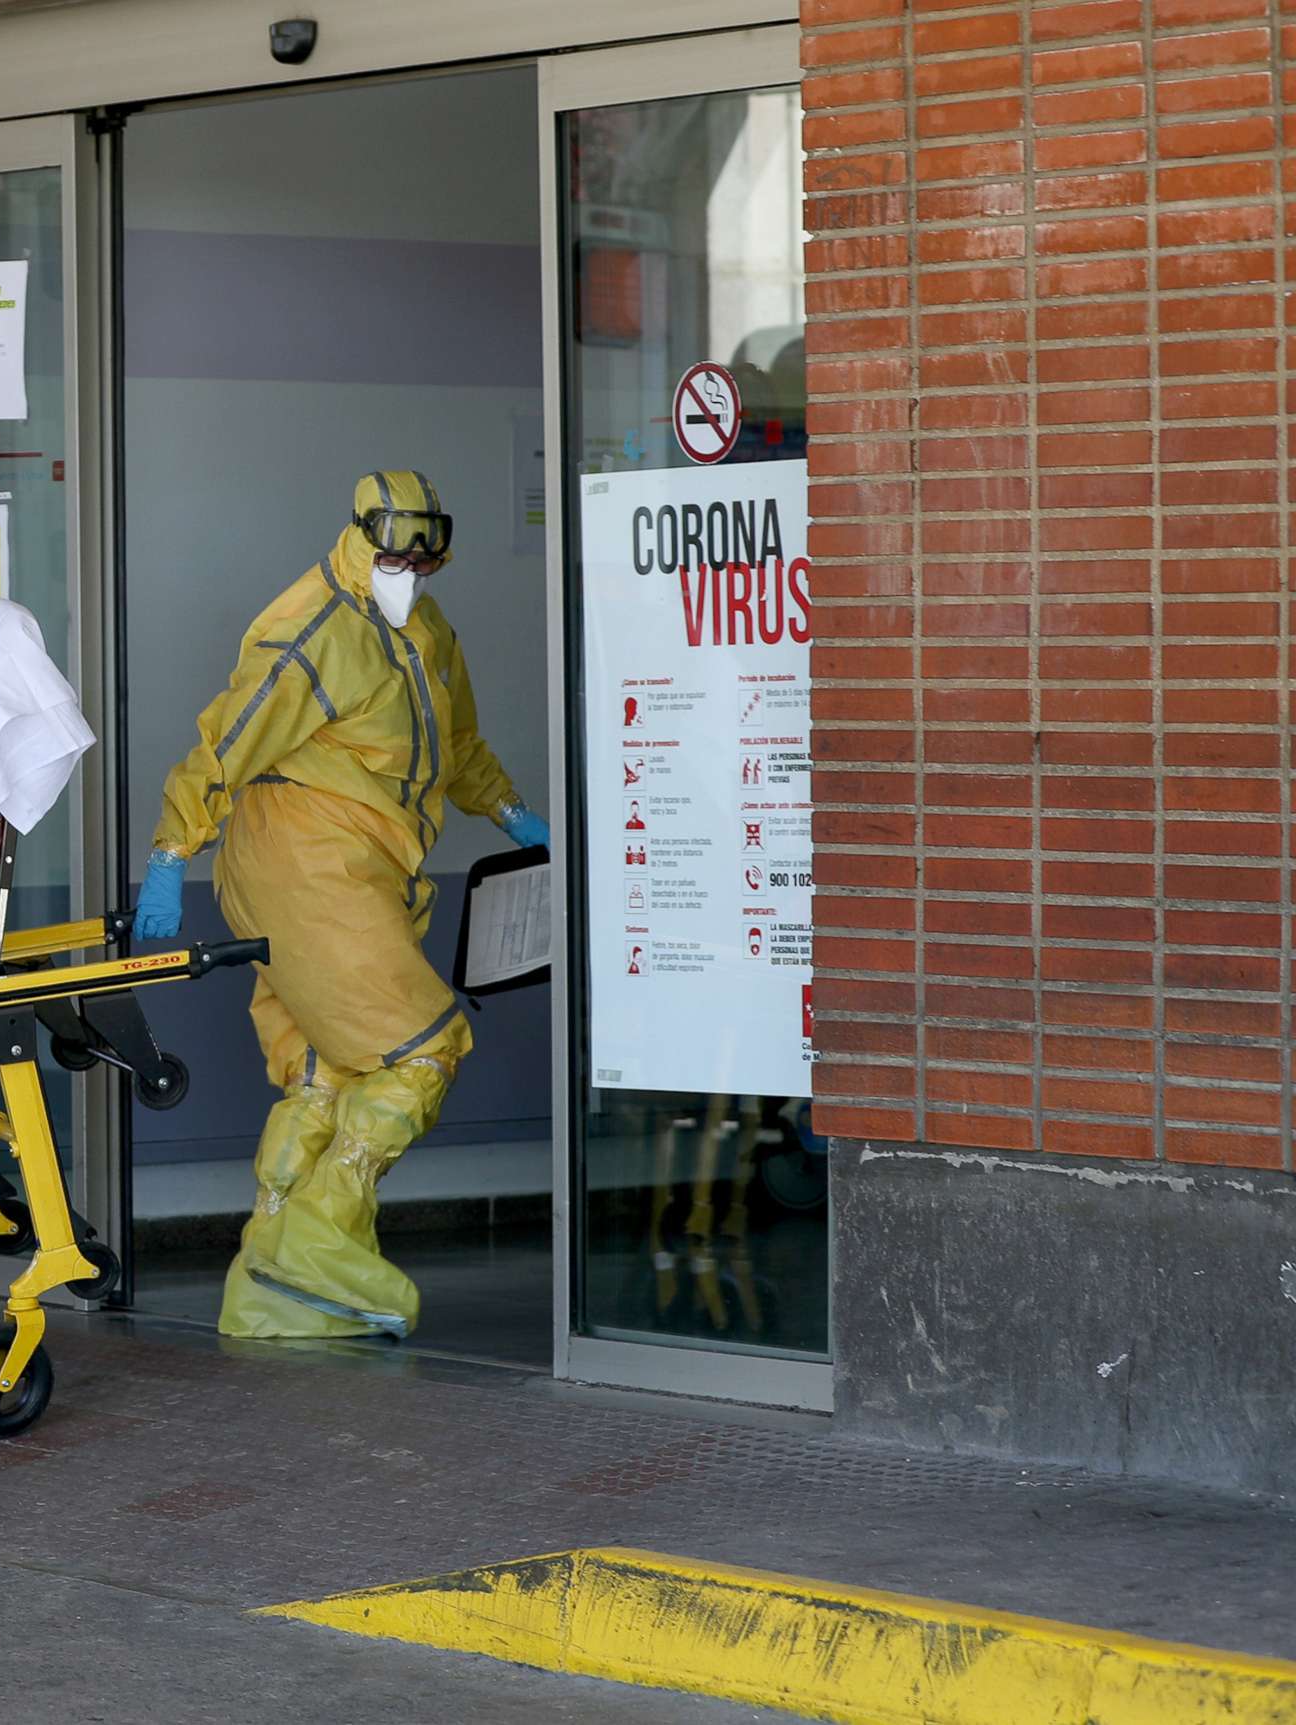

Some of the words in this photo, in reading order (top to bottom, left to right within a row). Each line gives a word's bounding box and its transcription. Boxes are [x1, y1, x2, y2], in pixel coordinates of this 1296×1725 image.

[633, 498, 785, 576] CORONA
[678, 556, 812, 647] VIRUS
[769, 872, 789, 887] 900
[792, 872, 812, 887] 102
[120, 955, 181, 970] TG-230
